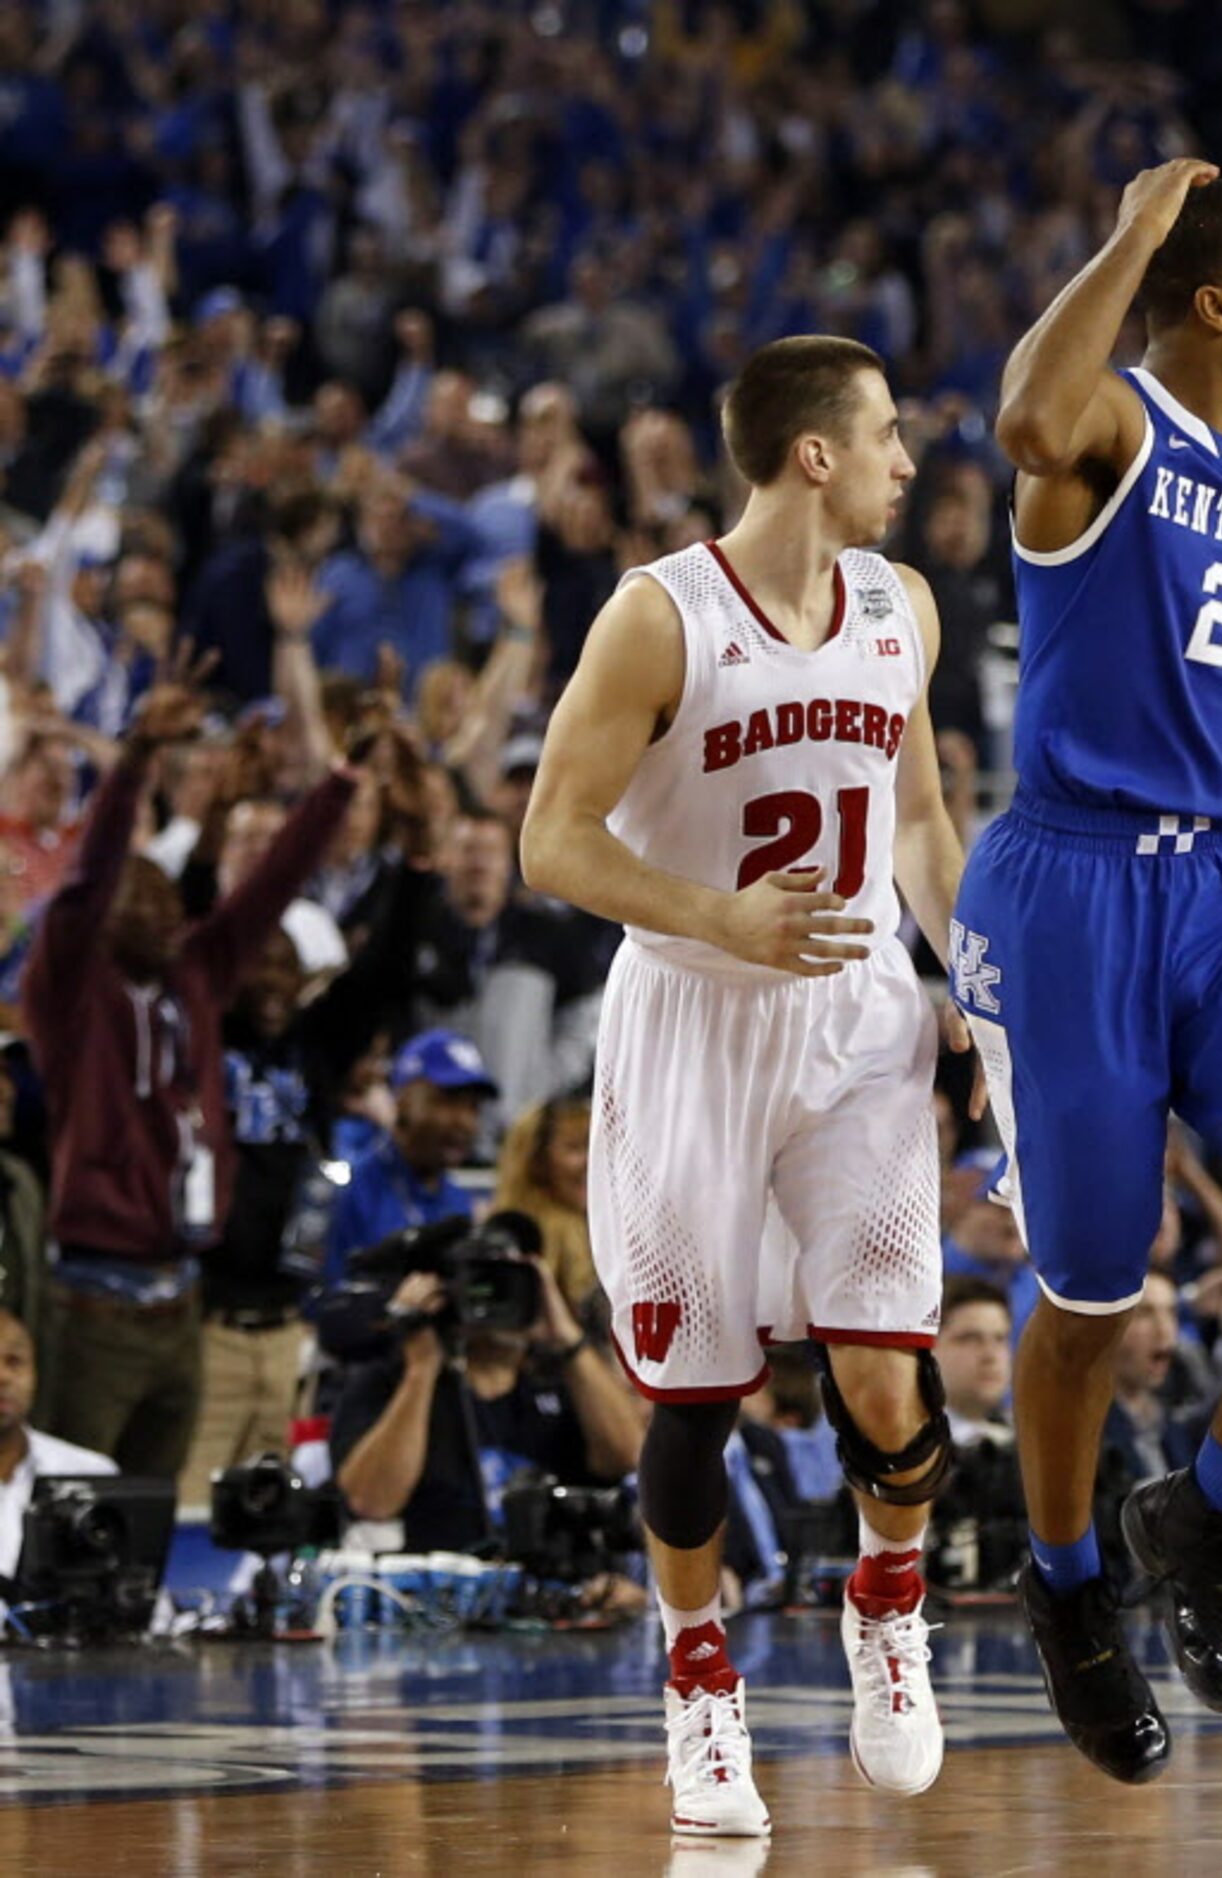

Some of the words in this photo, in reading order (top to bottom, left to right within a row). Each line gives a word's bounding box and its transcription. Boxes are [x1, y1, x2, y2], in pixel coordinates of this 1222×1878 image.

[703, 698, 905, 773] BADGERS
[737, 786, 869, 900] 21
[632, 1302, 682, 1364] W
